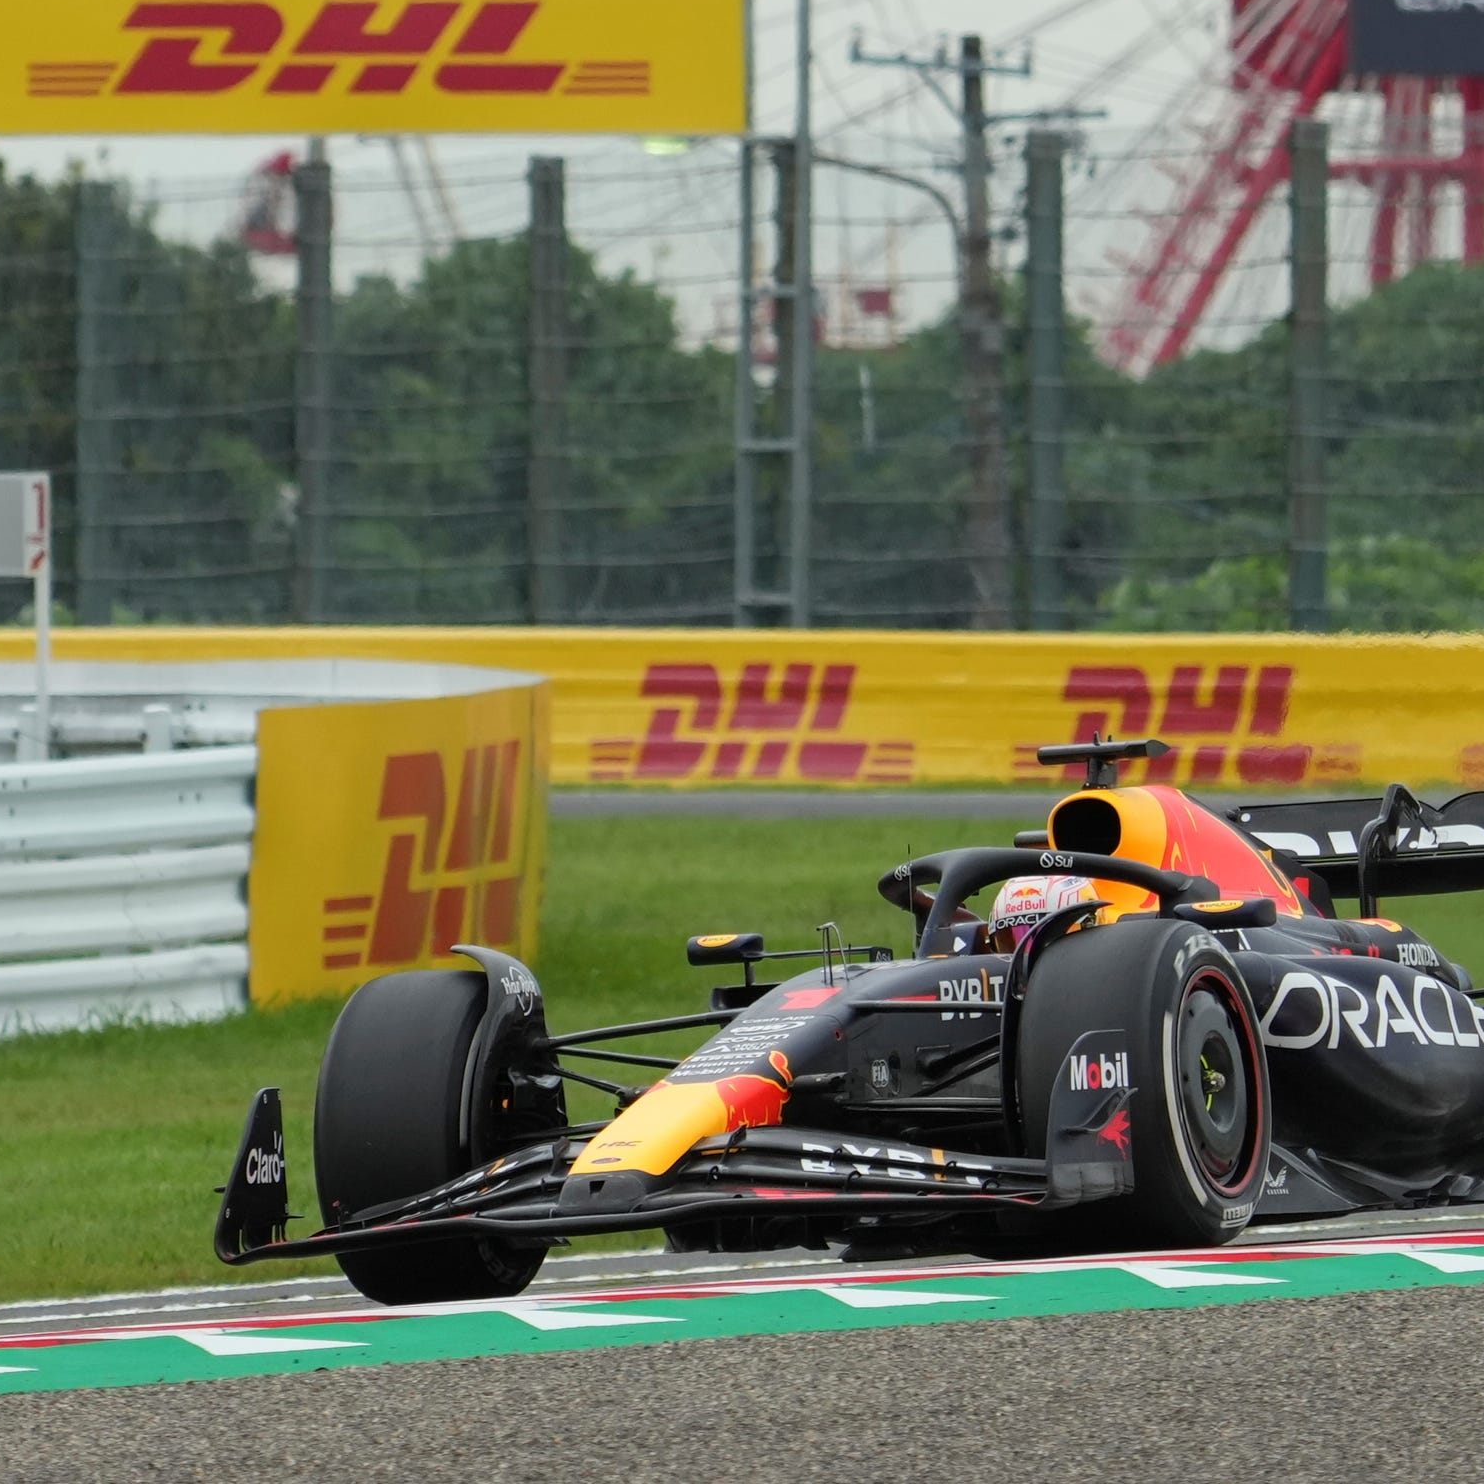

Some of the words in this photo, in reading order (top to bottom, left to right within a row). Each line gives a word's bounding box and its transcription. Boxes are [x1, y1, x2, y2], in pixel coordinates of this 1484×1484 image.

[113, 0, 566, 95] DHL
[634, 663, 869, 779] DHL
[1063, 665, 1313, 783] DHL
[368, 740, 520, 967] DHL
[1054, 854, 1074, 868] Sui
[996, 913, 1040, 930] ORACL
[1005, 900, 1024, 914] Red
[1024, 898, 1046, 911] Bull
[1396, 943, 1440, 967] HONDA
[779, 987, 843, 1011] 1
[715, 1033, 790, 1044] zoom
[1070, 1051, 1129, 1092] Mobil
[245, 1147, 281, 1185] Claro
